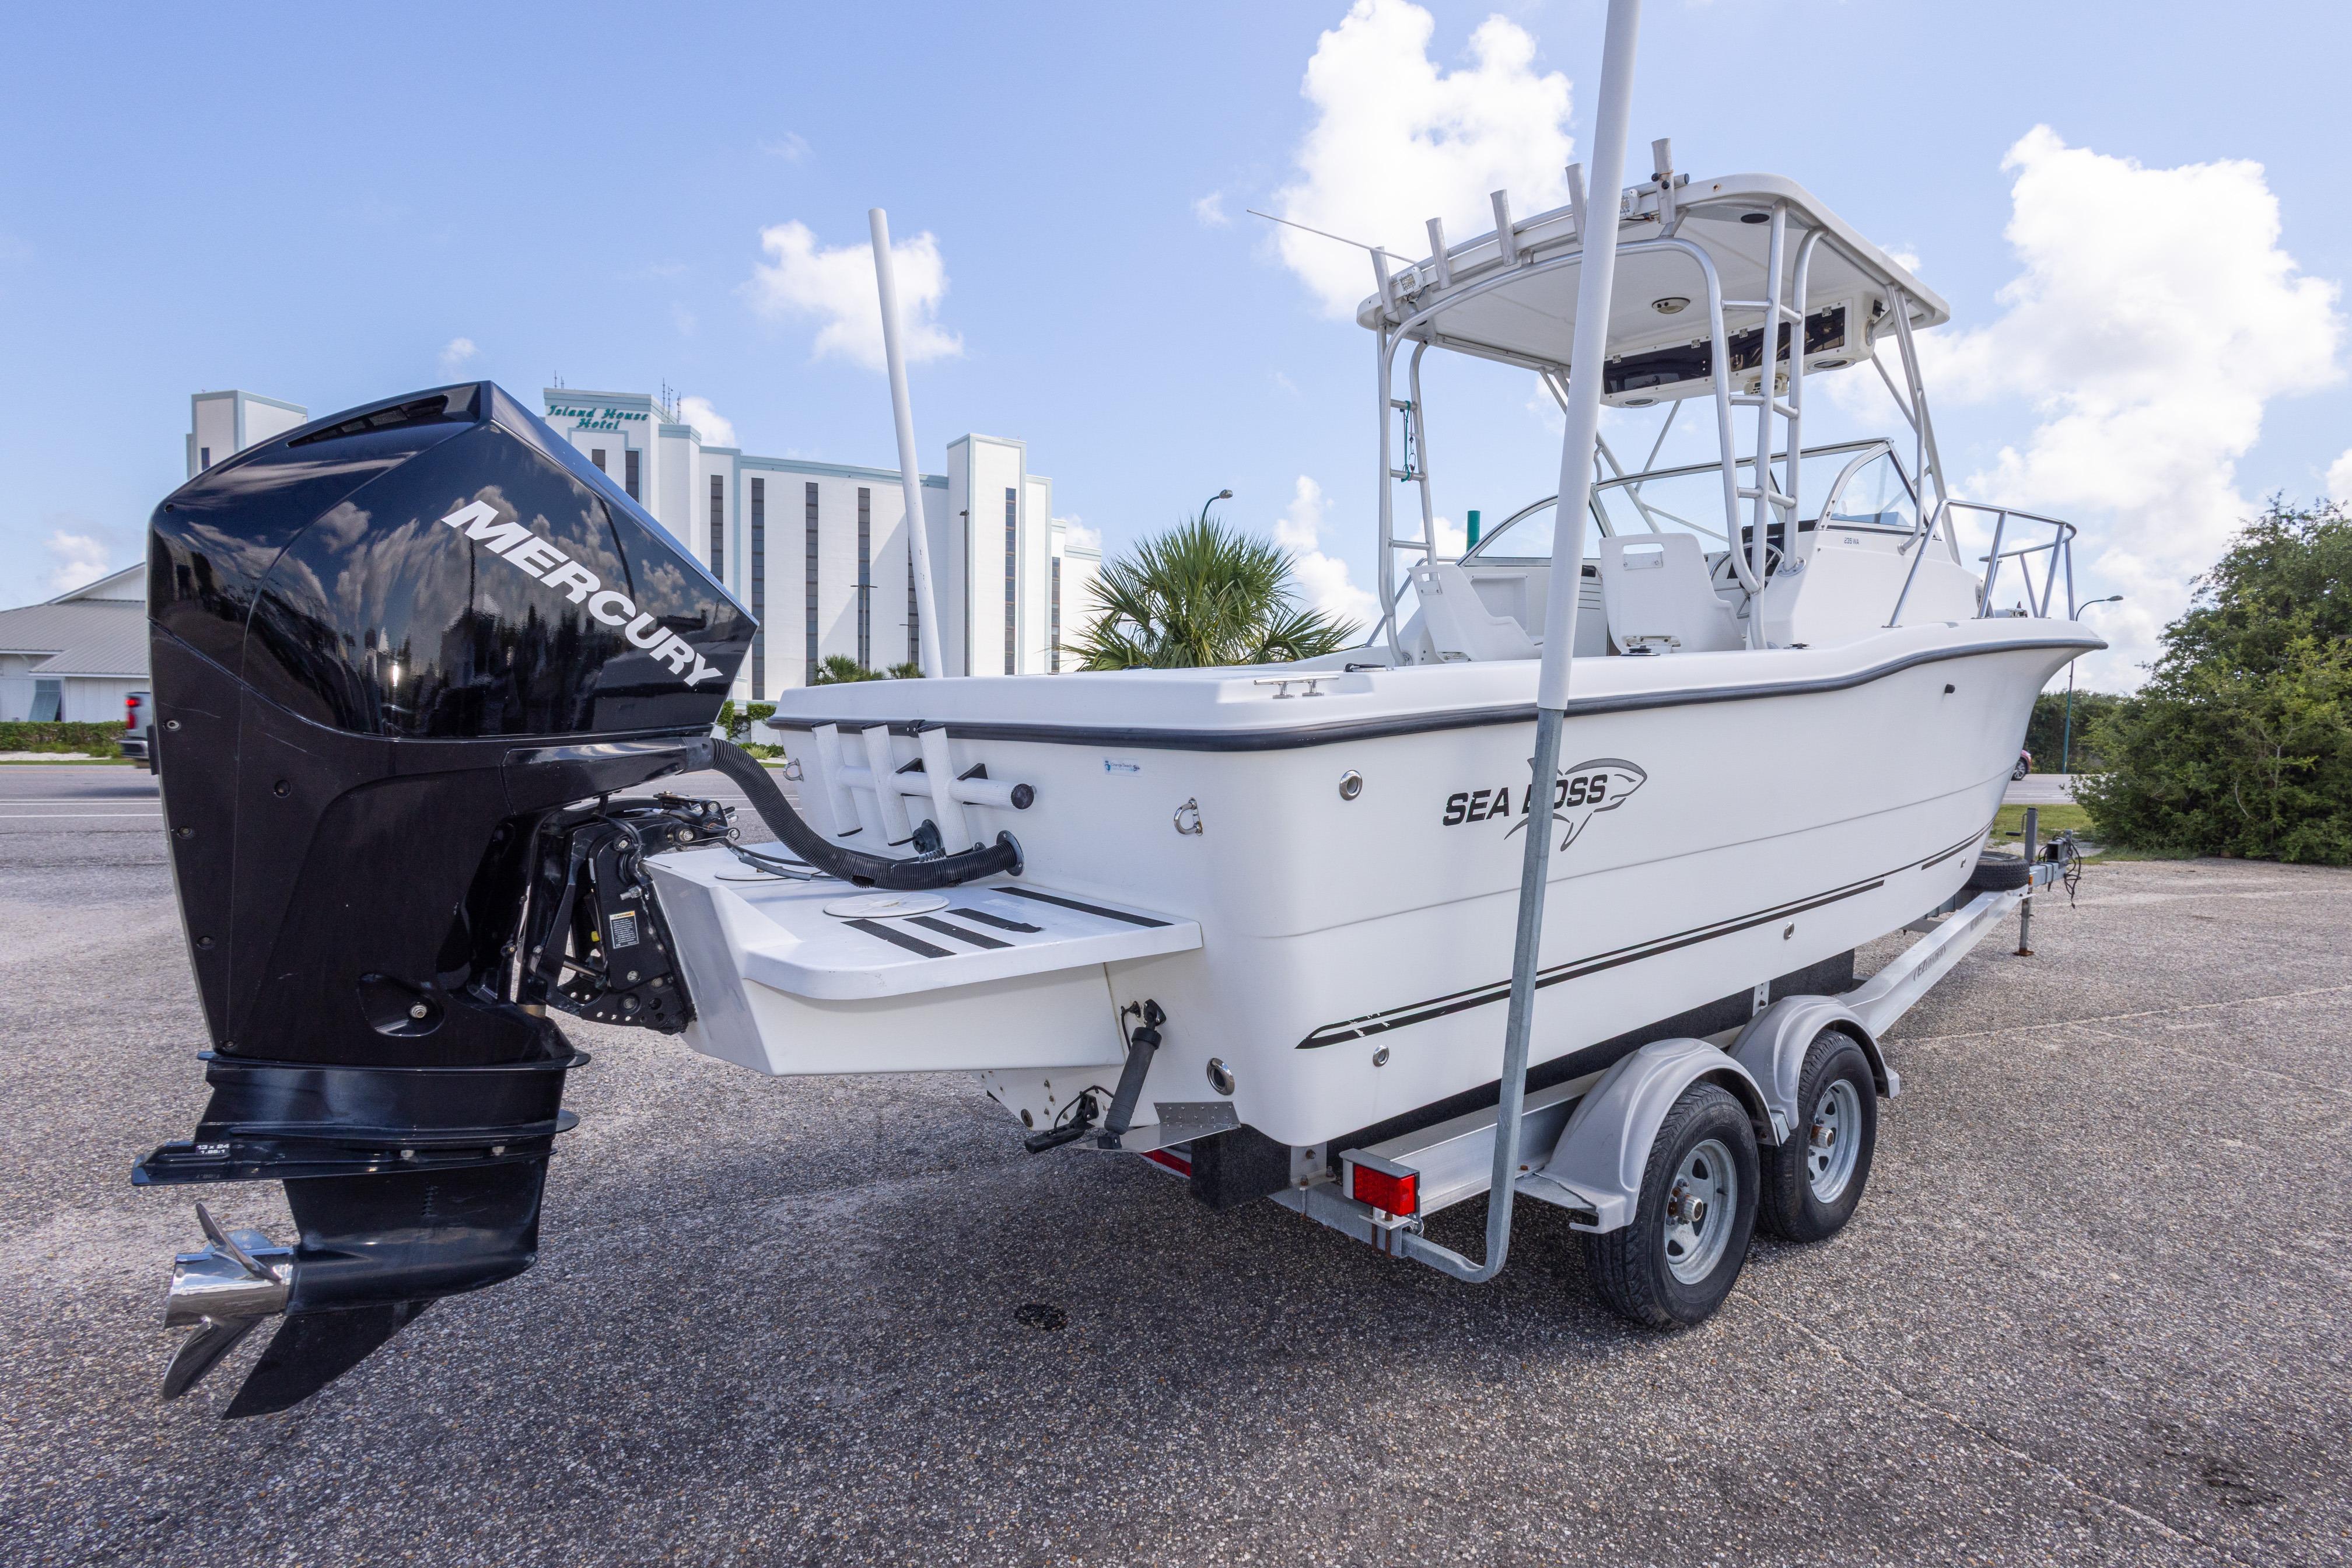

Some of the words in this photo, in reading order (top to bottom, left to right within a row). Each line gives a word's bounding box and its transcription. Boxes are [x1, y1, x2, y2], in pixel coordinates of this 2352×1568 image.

[547, 405, 597, 418] Island
[601, 408, 649, 421] House
[576, 418, 621, 430] Hotel
[440, 500, 723, 687] MERCURY
[1443, 787, 1510, 826] SEA
